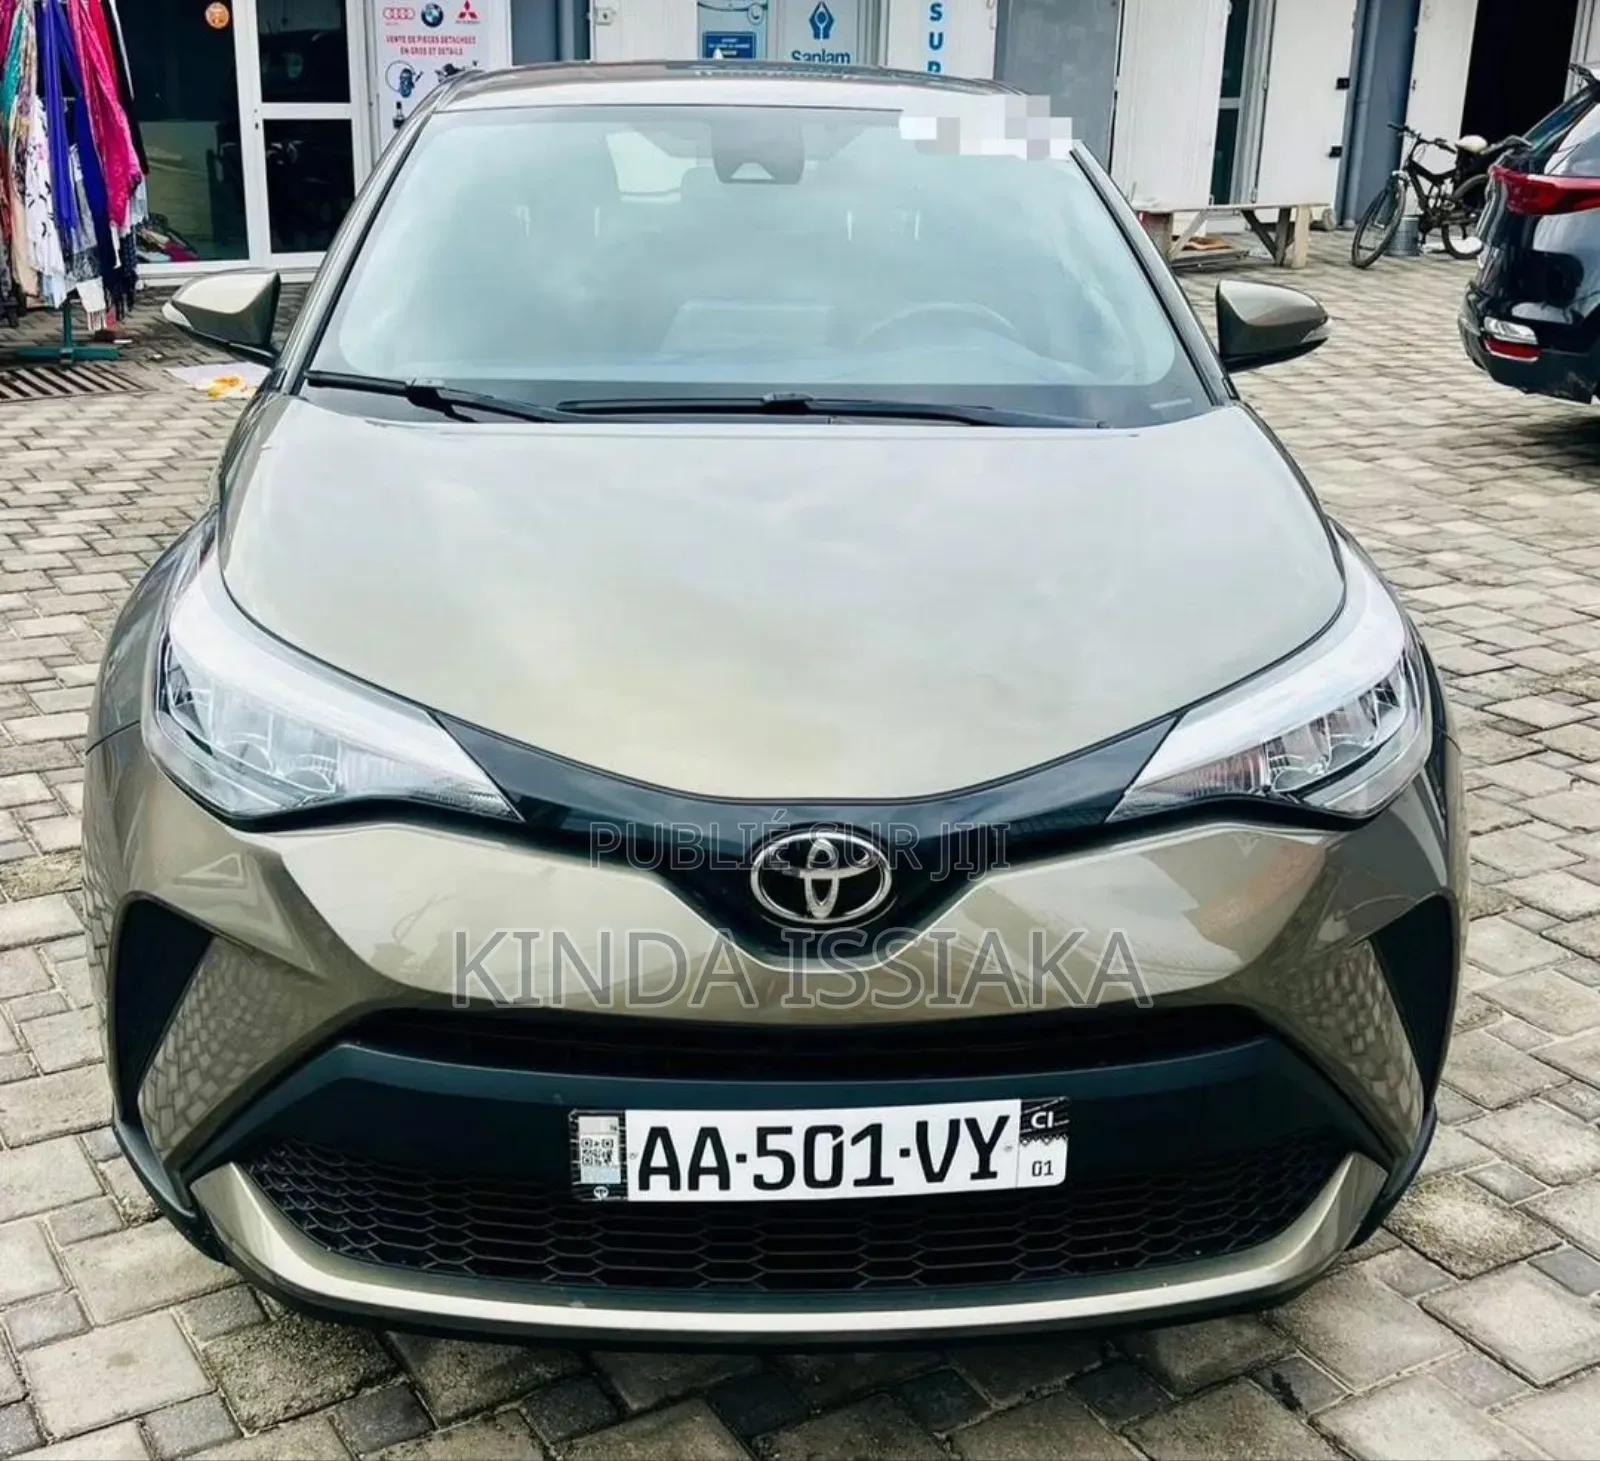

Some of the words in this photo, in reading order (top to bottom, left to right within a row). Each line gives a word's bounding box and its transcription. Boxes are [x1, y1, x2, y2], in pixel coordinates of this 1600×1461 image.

[385, 35, 406, 44] VENTE
[407, 35, 416, 44] DE
[400, 46, 409, 55] EN
[410, 46, 427, 56] GROS
[428, 46, 437, 56] ET
[791, 49, 851, 64] Sanlam
[1030, 1110, 1055, 1129] CI
[1031, 1159, 1054, 1178] 01
